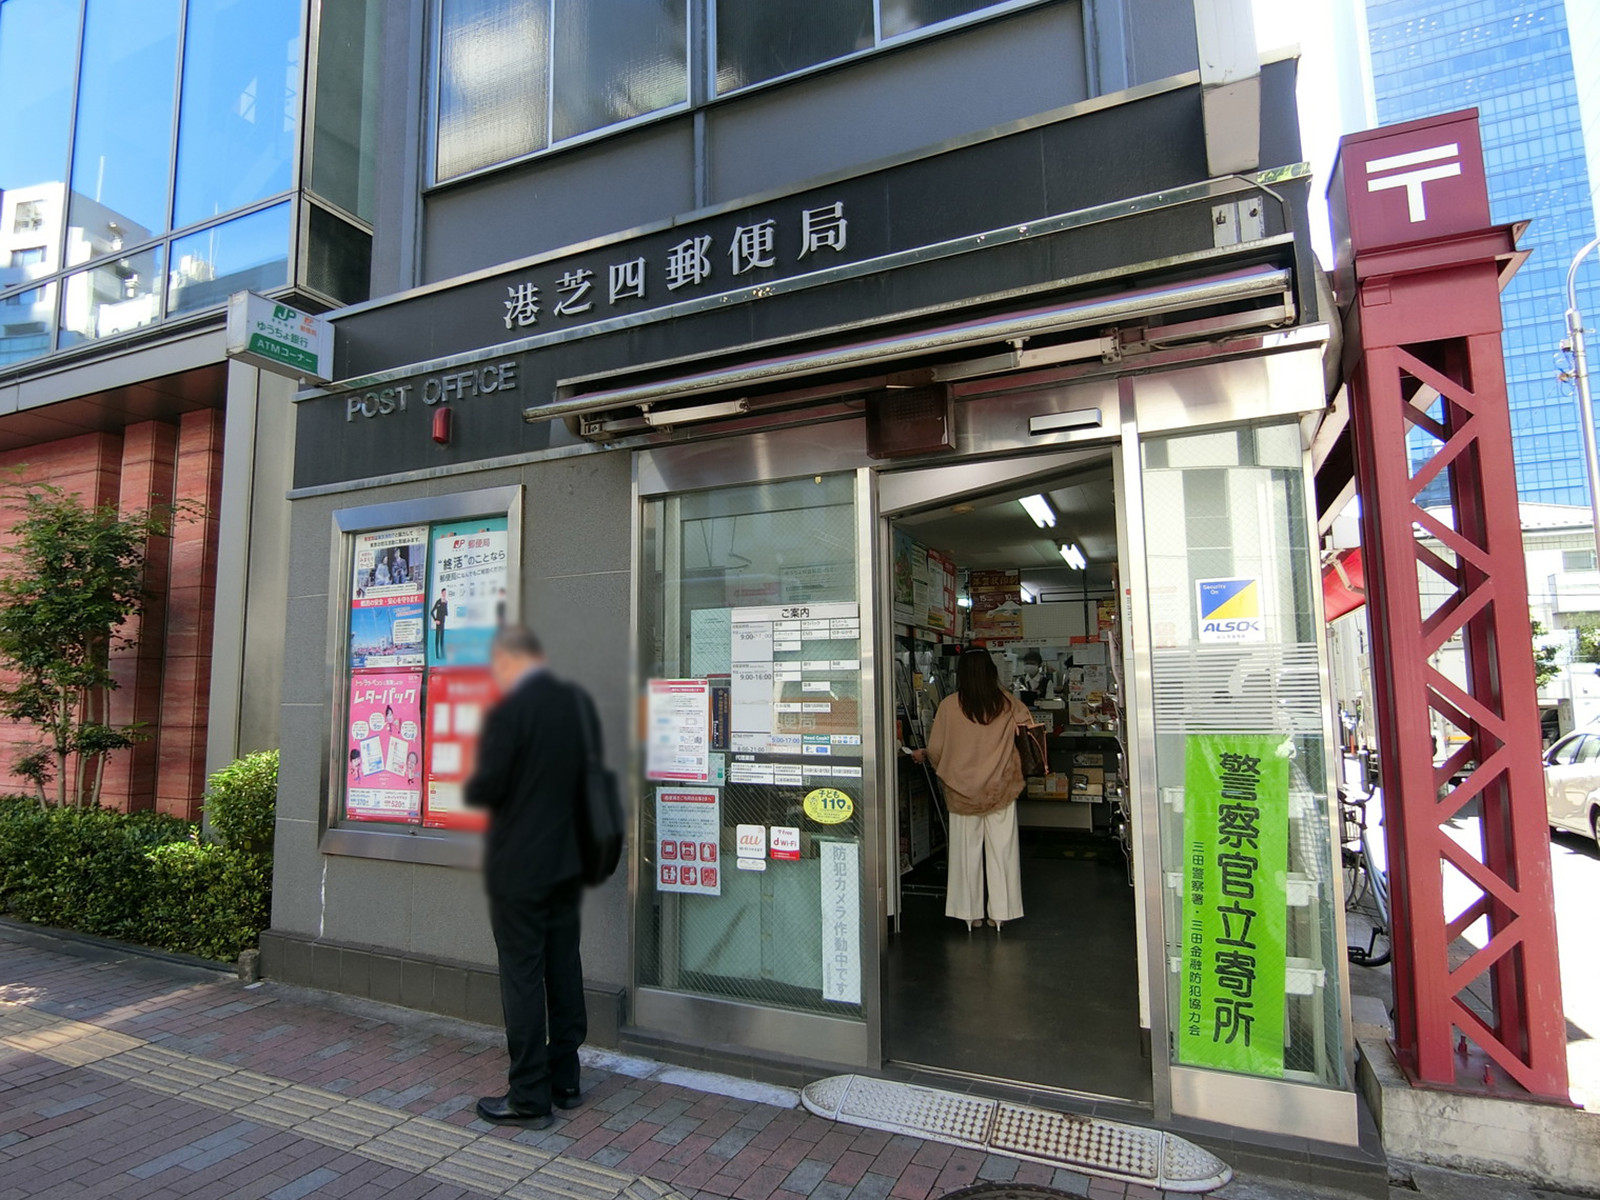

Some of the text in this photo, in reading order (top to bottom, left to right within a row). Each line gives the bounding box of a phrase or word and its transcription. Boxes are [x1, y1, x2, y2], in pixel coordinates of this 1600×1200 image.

[503, 201, 848, 329] 港芝四郵便局
[256, 321, 308, 348] ゆうちょ銀行
[257, 340, 312, 363] ATMコーナー
[347, 362, 517, 422] POST OFFICE
[782, 608, 810, 618] ご案内
[1203, 620, 1260, 632] ALSOK
[353, 687, 416, 704] レターパック
[818, 790, 840, 798] 子ども
[740, 834, 762, 846] au
[1212, 752, 1262, 1048] 警察官立寄所
[832, 845, 848, 996] 防犯カメラ作動中です
[1188, 841, 1205, 1037] 三田警察署・三田金融防犯協力会
